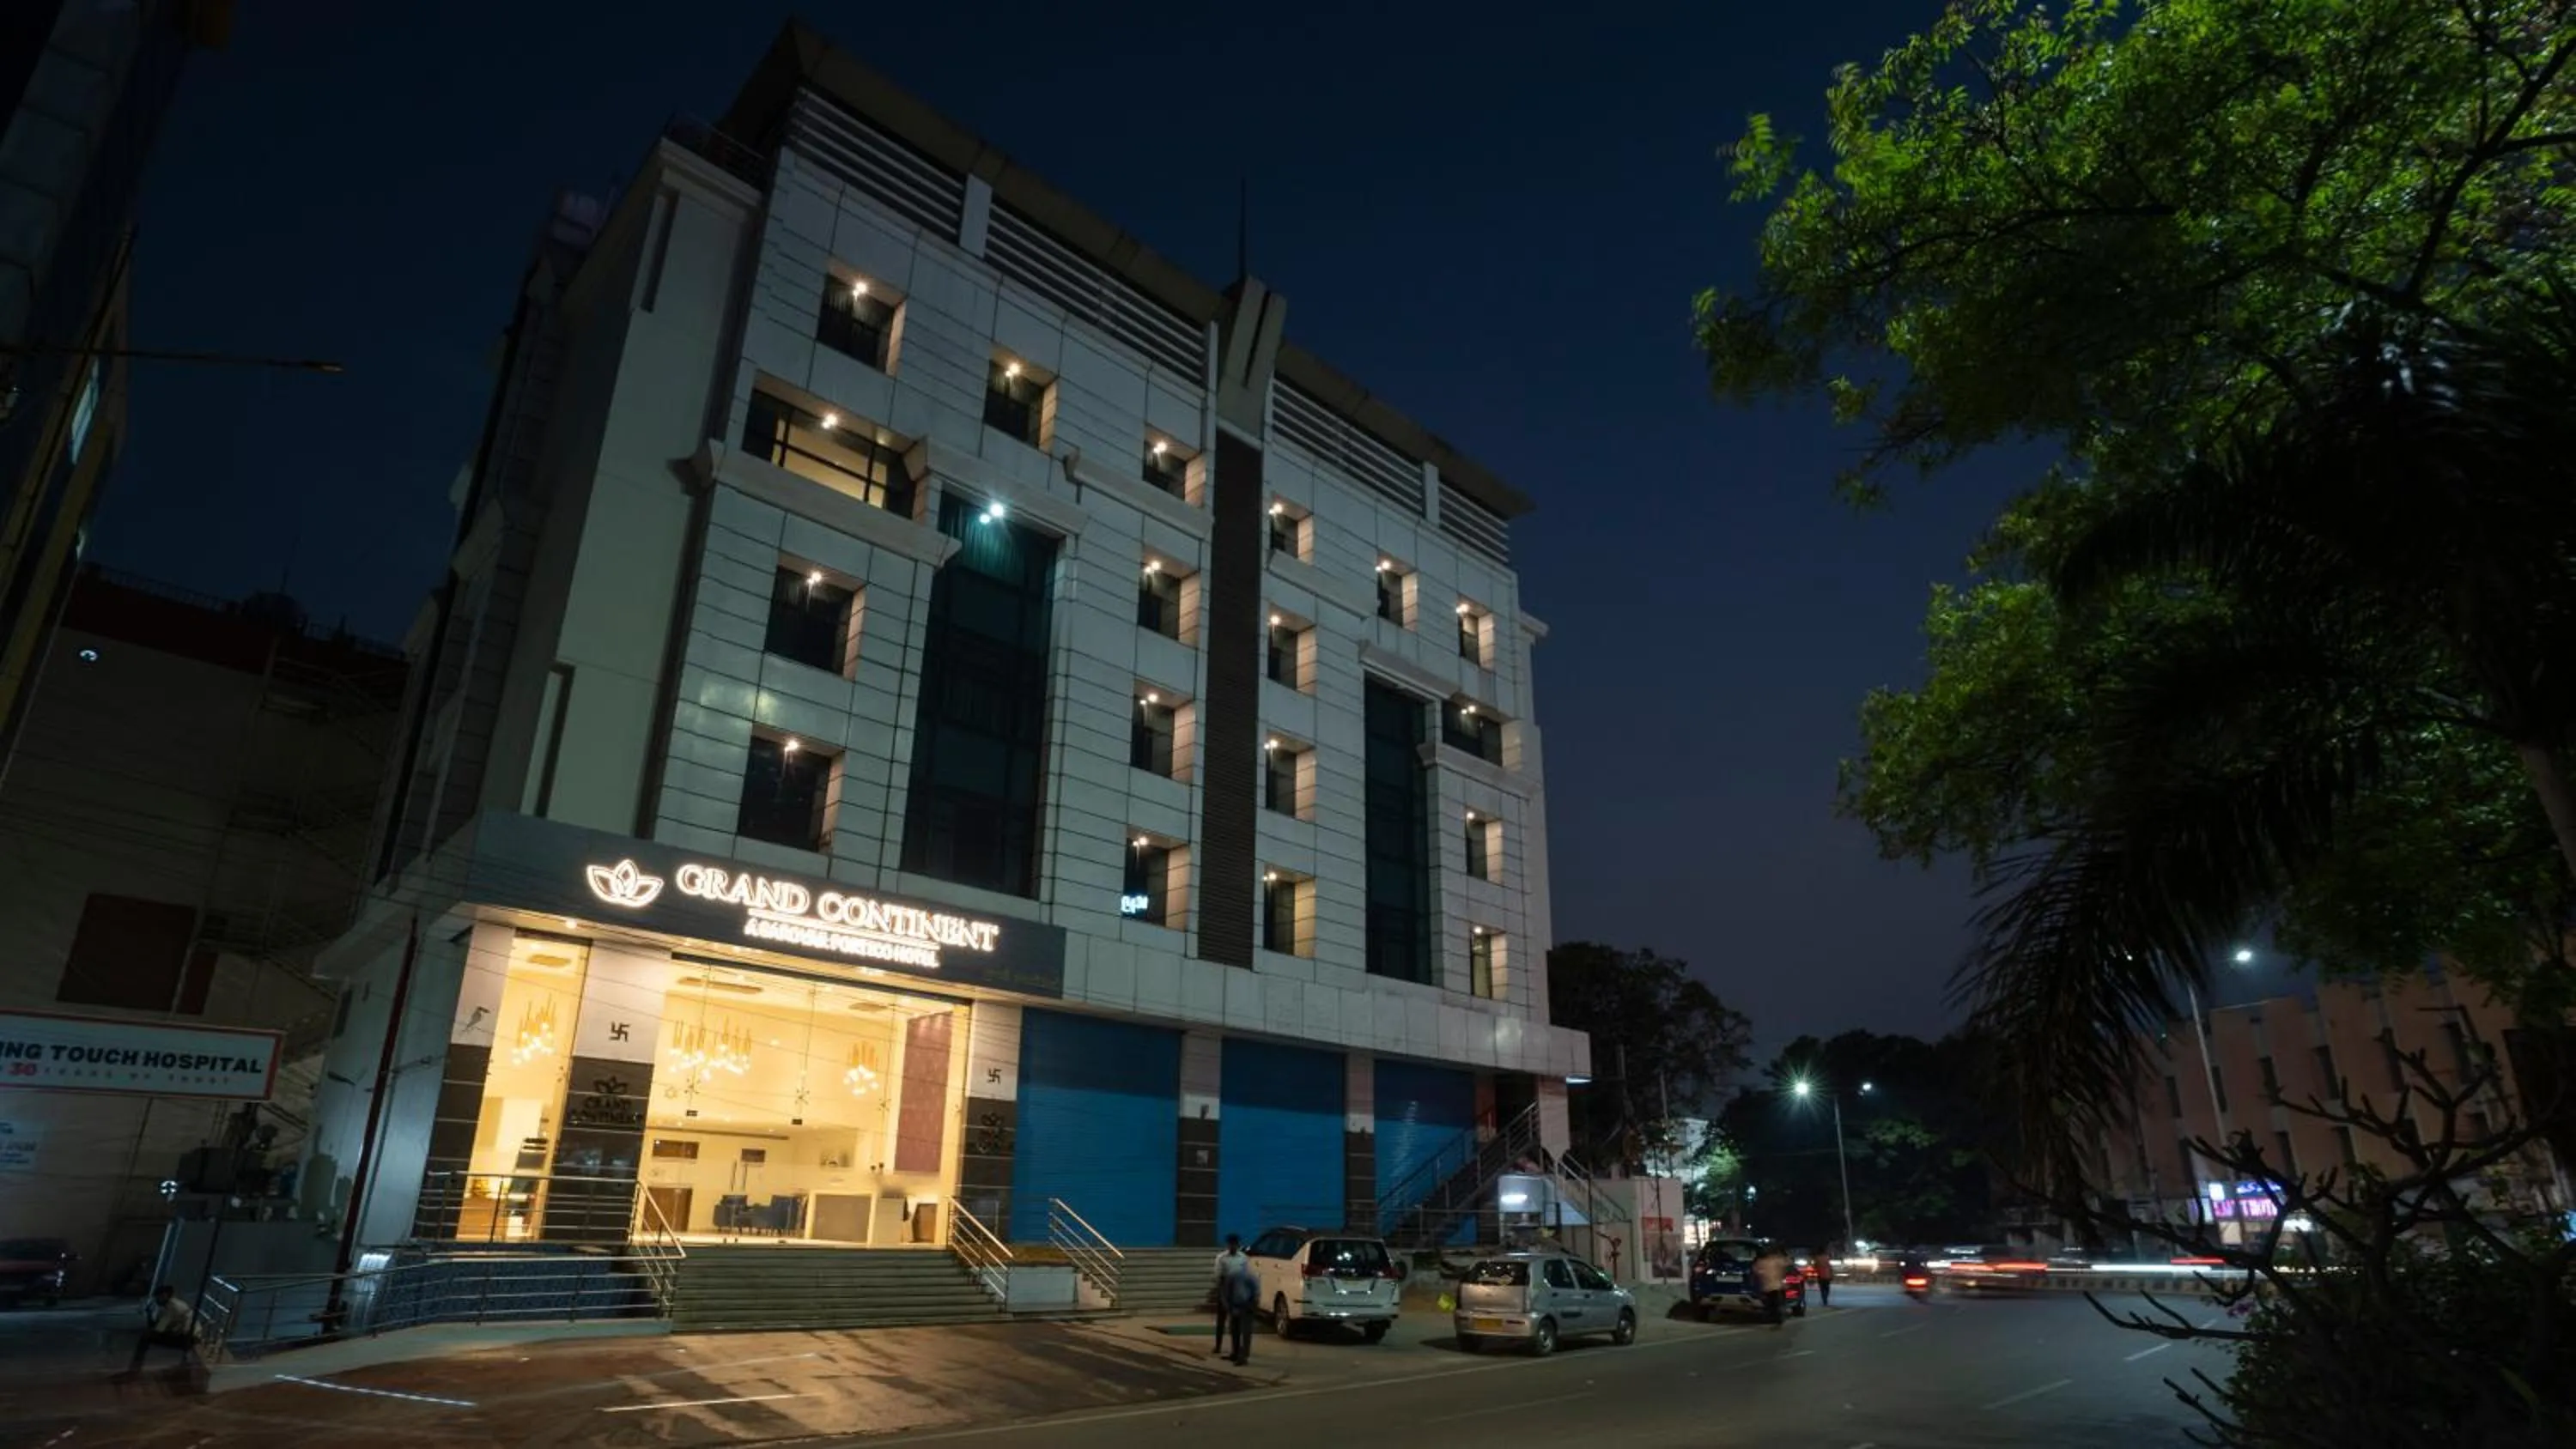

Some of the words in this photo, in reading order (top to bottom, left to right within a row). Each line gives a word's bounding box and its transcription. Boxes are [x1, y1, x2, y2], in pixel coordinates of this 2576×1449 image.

[676, 864, 811, 915] GRAND
[817, 891, 1000, 951] CONTINENT
[50, 1045, 139, 1066] TOUCH
[142, 1052, 263, 1074] HOSPITAL
